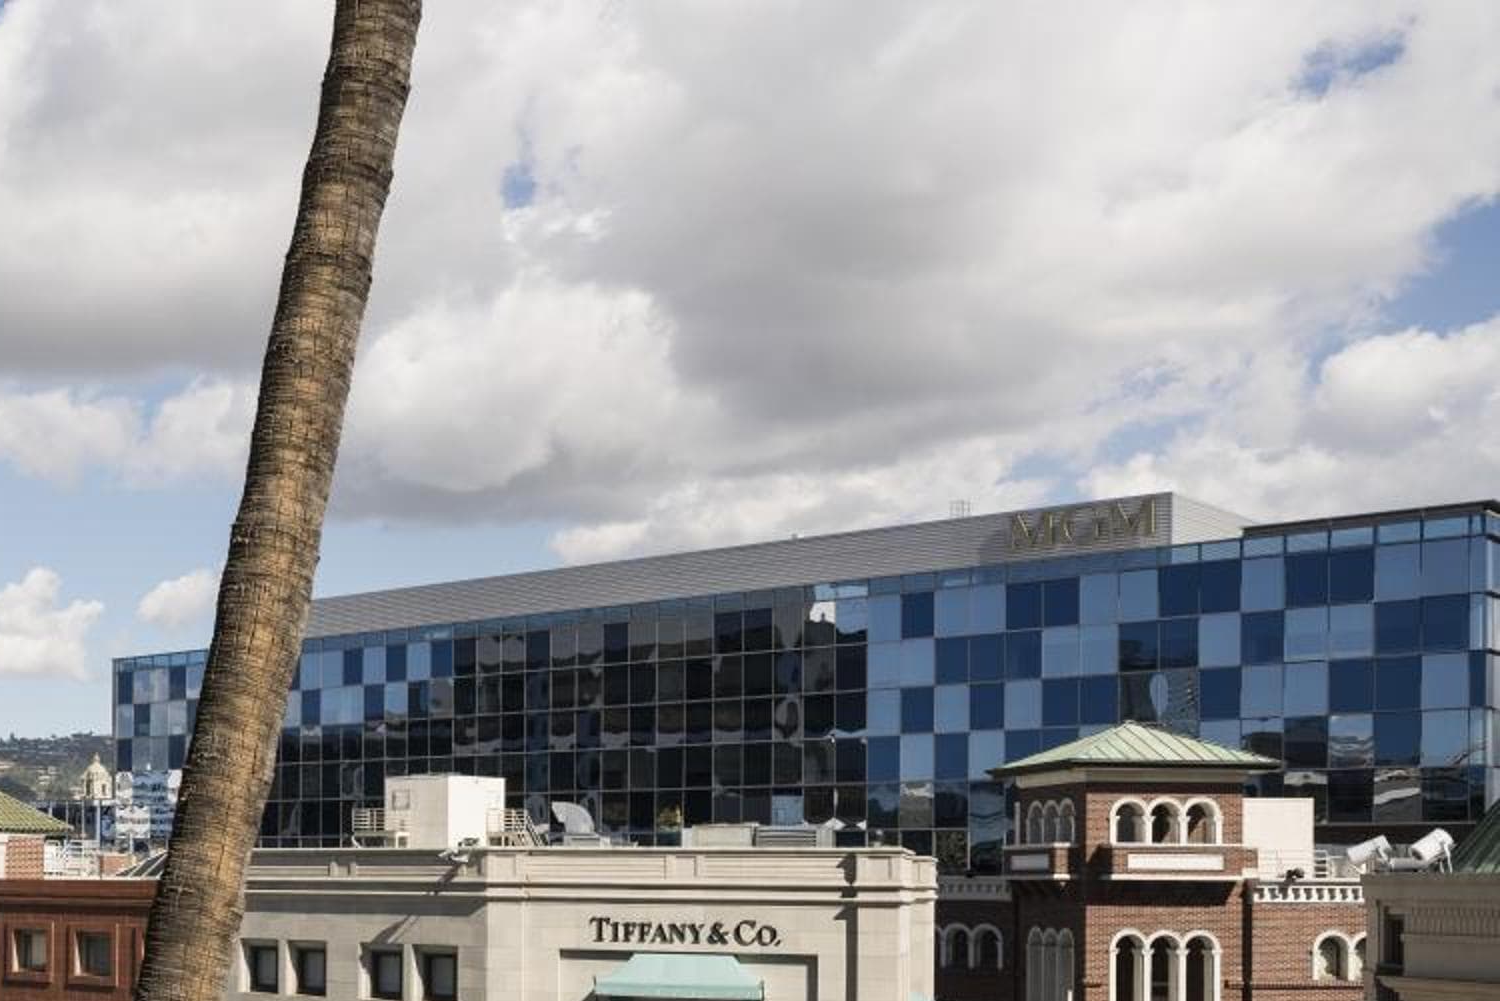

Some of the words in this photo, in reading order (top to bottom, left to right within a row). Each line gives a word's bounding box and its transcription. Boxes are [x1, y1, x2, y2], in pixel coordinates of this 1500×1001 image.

[1011, 496, 1157, 551] MGM
[590, 917, 704, 945] TIFFANY
[707, 922, 729, 945] &
